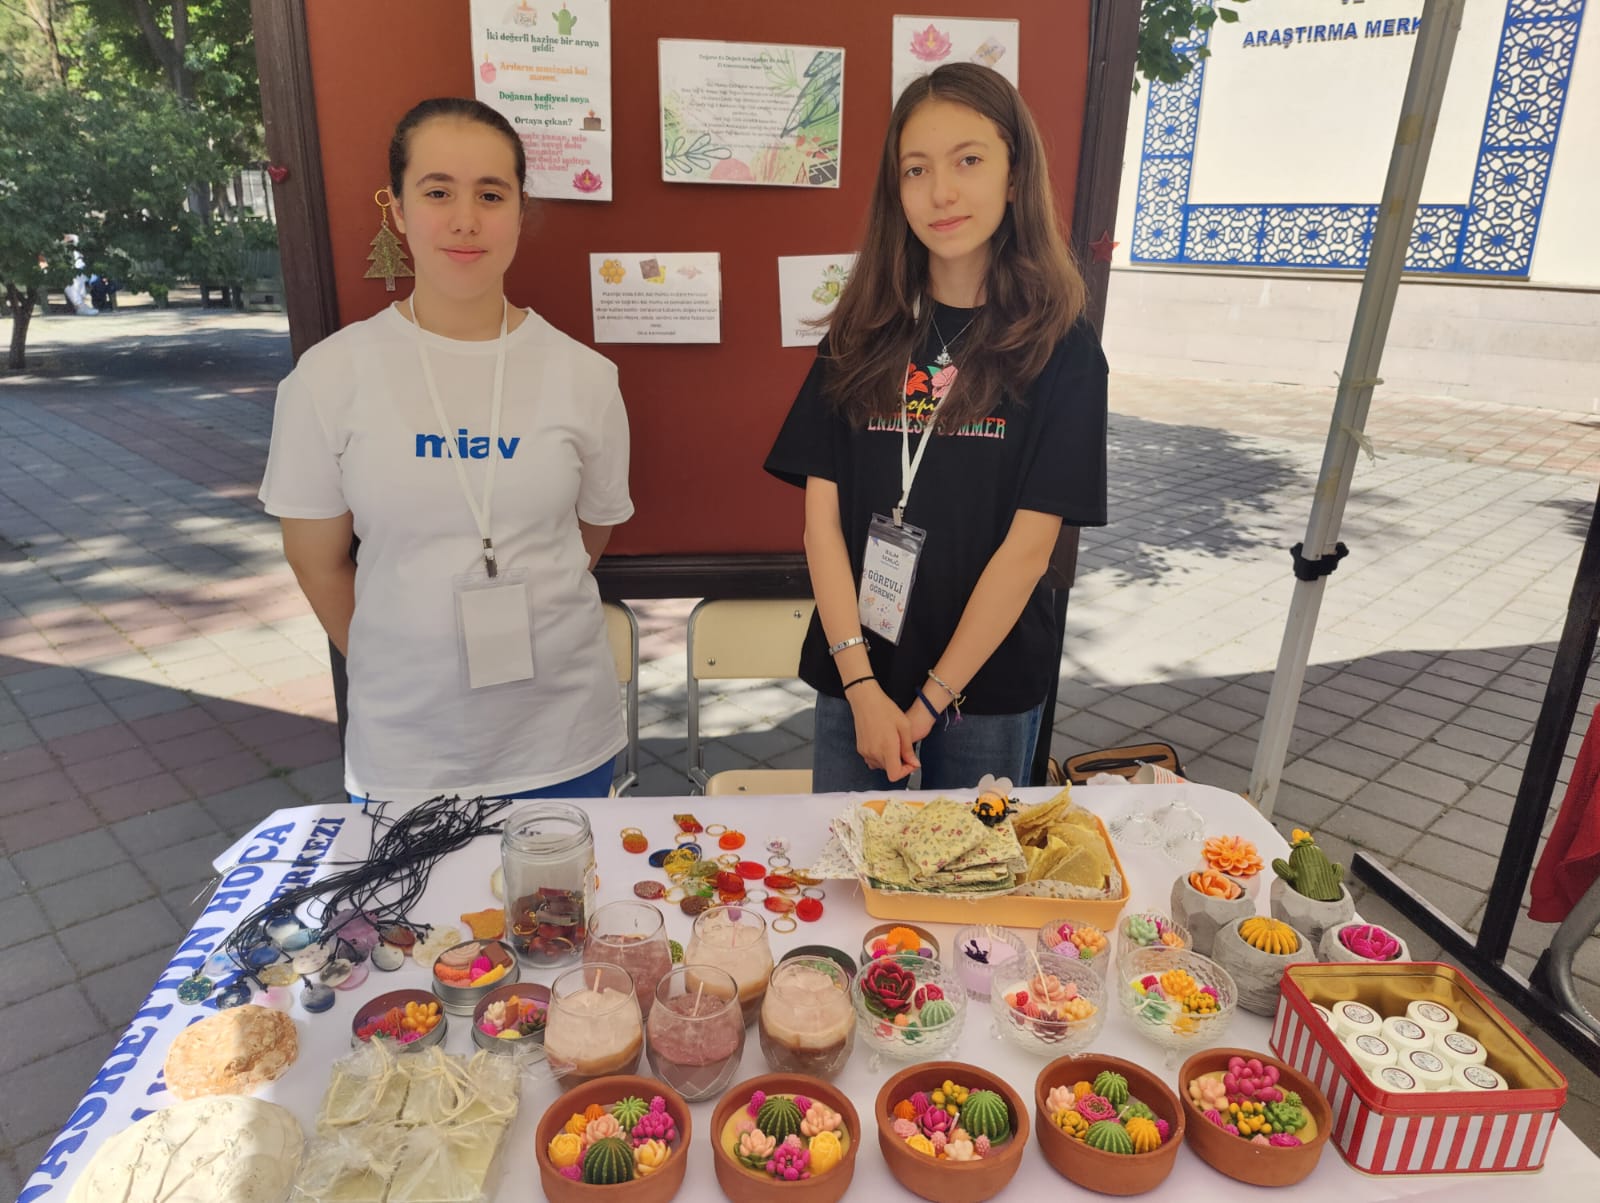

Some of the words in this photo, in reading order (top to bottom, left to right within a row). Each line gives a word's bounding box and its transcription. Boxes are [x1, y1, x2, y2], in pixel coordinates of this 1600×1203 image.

[500, 32, 529, 43] değerli
[1243, 22, 1358, 48] ARAŞTIRMA
[1364, 16, 1422, 38] MERK
[499, 91, 532, 101] Doğanın
[534, 93, 568, 103] hediyesi
[514, 116, 542, 126] Ortaya
[544, 117, 573, 127] çıkan?
[416, 428, 520, 459] miav
[201, 822, 296, 917] HOCA
[264, 817, 346, 920] ERKEZİ
